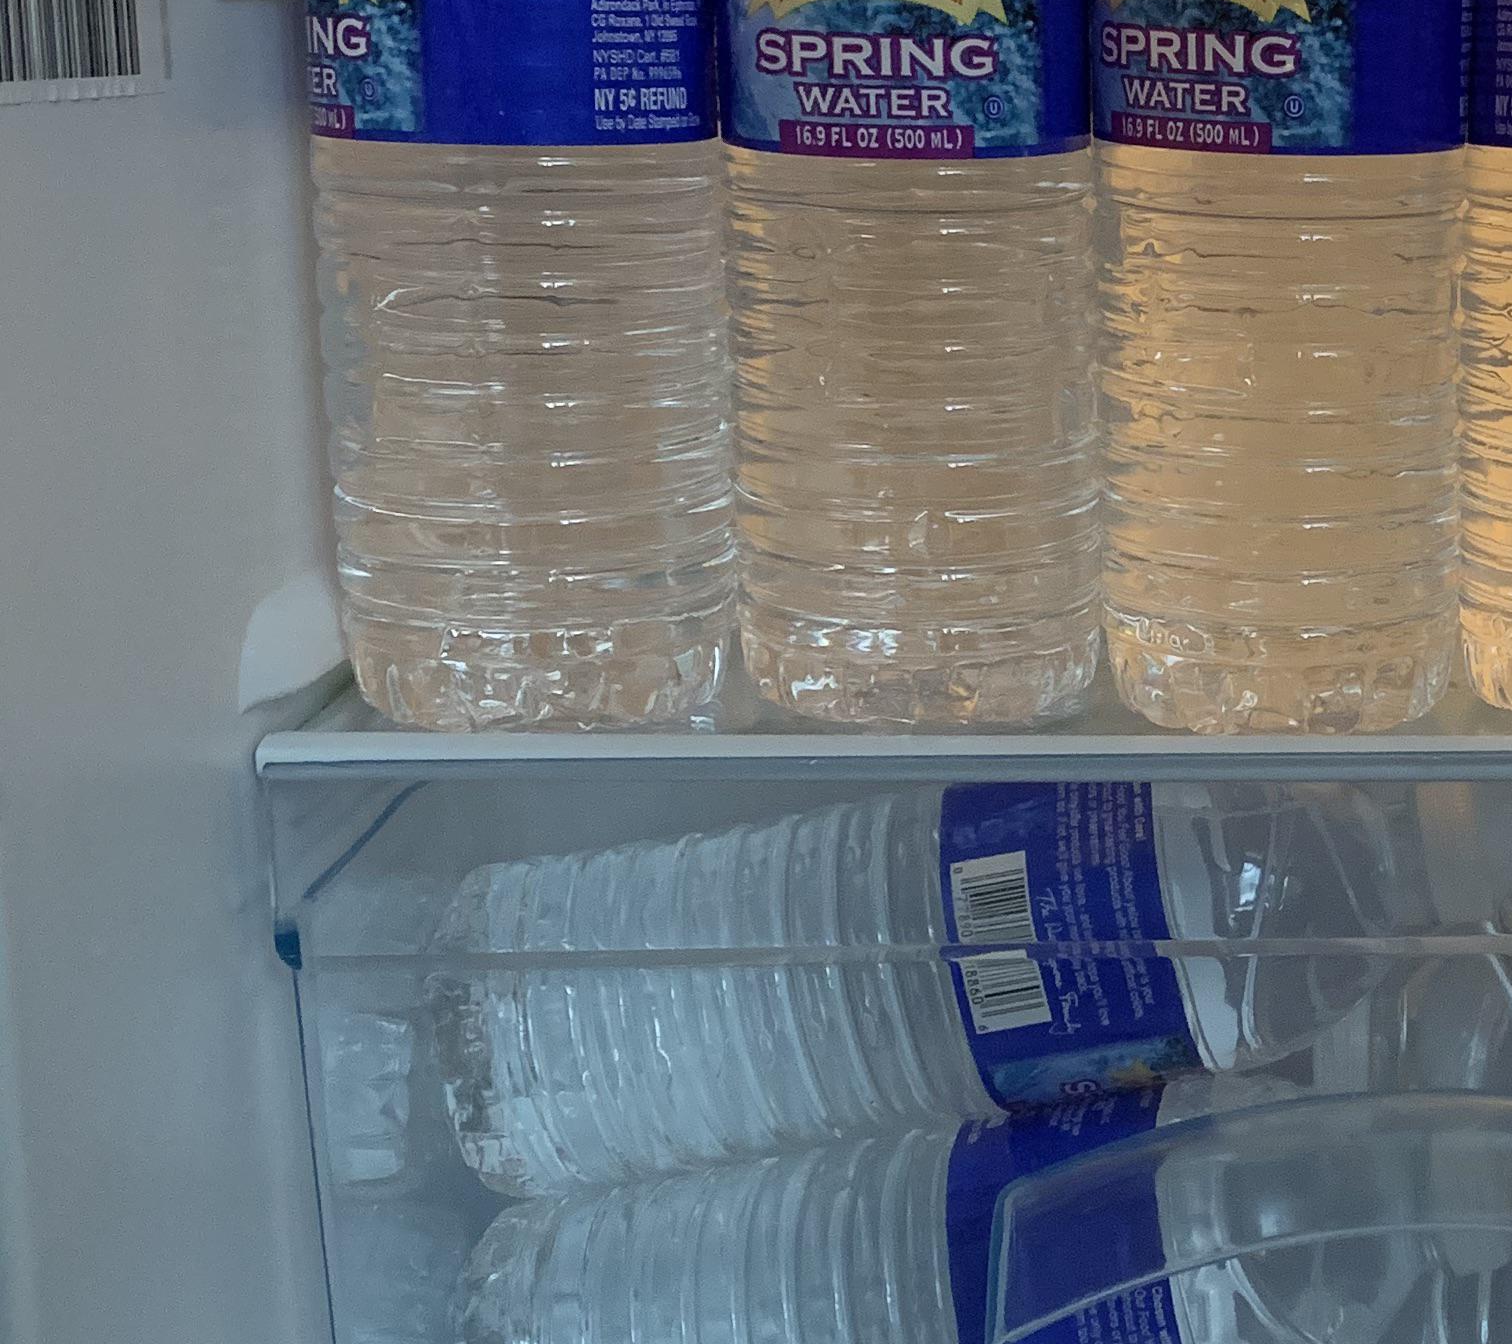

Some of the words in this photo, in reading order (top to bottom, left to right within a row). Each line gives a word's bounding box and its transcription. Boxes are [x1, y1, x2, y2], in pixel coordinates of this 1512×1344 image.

[757, 32, 996, 77] SPRING
[1102, 25, 1297, 75] SPRING
[594, 87, 615, 111] NY
[640, 86, 688, 110] REFUND
[798, 84, 951, 117] WATER
[1123, 77, 1248, 114] WATER
[1494, 94, 1509, 117] NY
[795, 125, 826, 146] 16.9
[830, 126, 852, 147] FL
[857, 127, 879, 147] OZ
[885, 127, 925, 150] (500
[1121, 117, 1144, 138] 16.9
[1147, 120, 1163, 140] FL
[1167, 122, 1184, 142] OZ
[1189, 123, 1225, 145] (500
